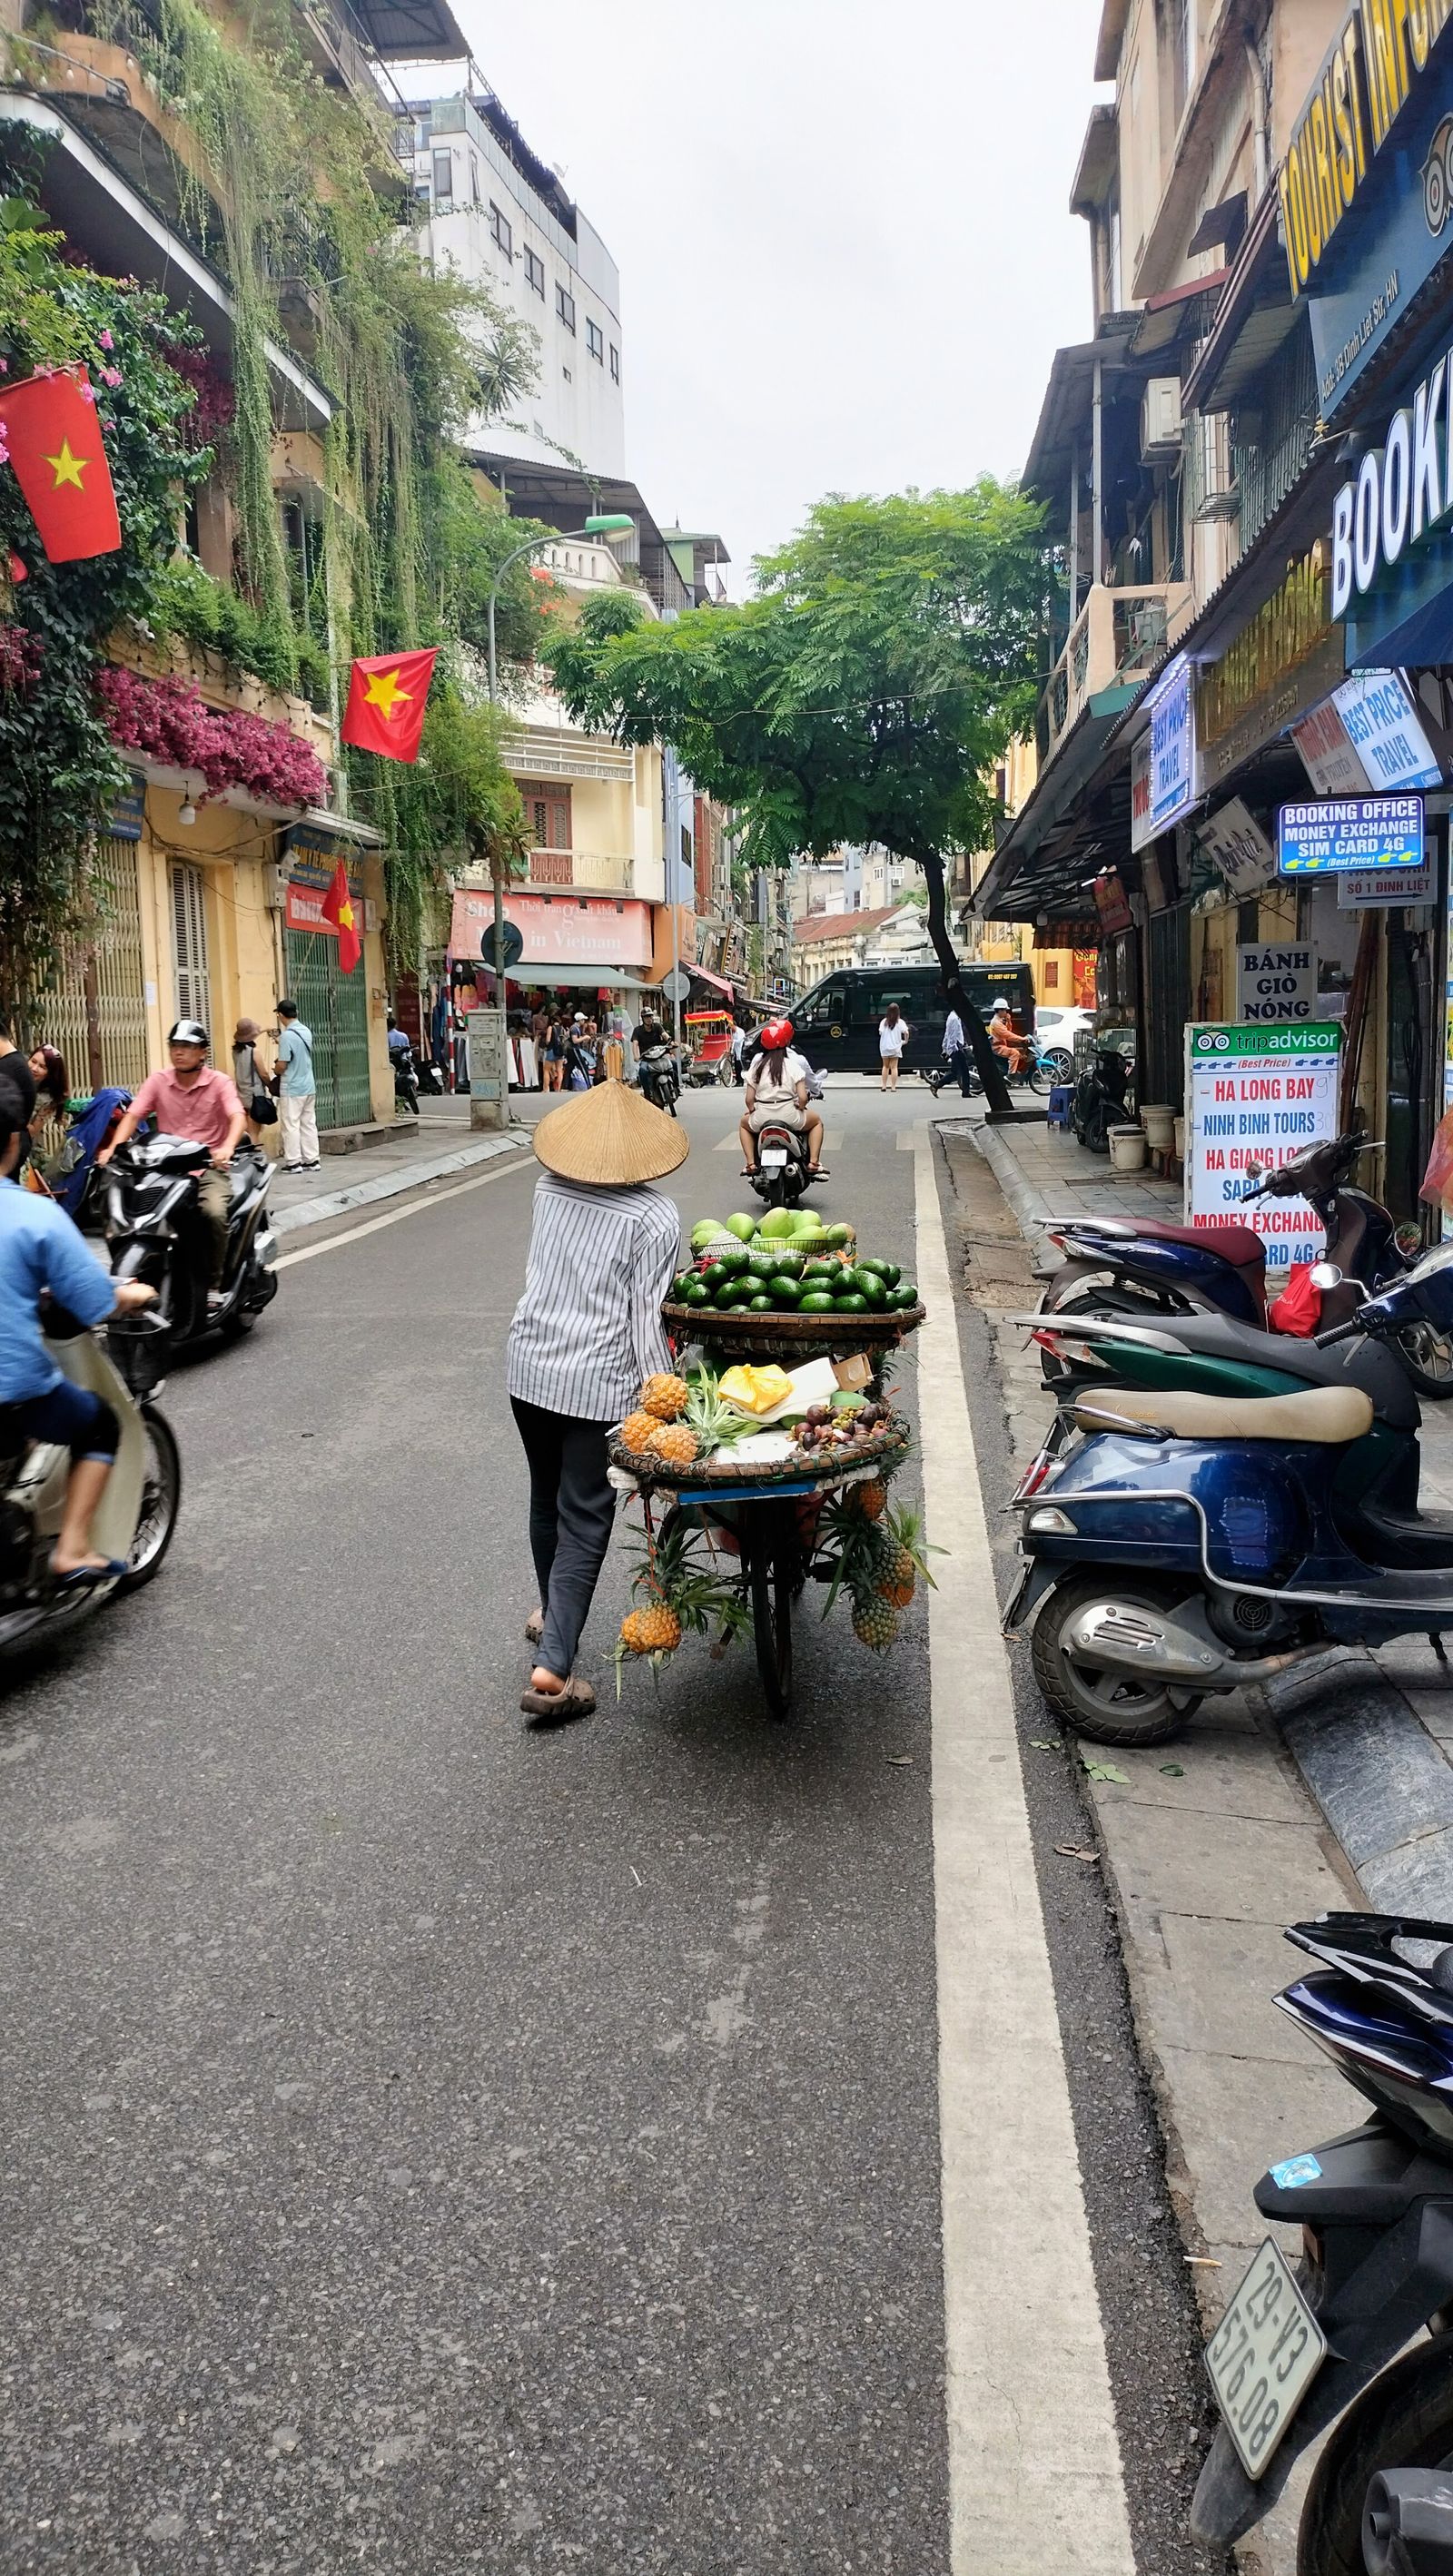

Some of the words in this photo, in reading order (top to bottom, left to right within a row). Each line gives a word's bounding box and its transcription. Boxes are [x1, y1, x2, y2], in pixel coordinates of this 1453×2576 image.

[1278, 9, 1366, 303] TOURIST
[1320, 367, 1337, 403] Add:
[1343, 330, 1360, 369] Dinh
[1359, 310, 1374, 346] Liet
[1385, 269, 1399, 308] HN
[1168, 686, 1189, 741] PRIC
[1341, 702, 1375, 745] BEST
[1365, 680, 1410, 730] PRICE
[1371, 734, 1419, 778] TRAVEL
[1159, 742, 1180, 795] TRAVEL
[1284, 804, 1358, 824] BOOKING
[1362, 800, 1418, 819] OFFICE
[1285, 825, 1337, 842] MONEY
[1340, 820, 1418, 838] EXCHANGE
[1298, 842, 1329, 857] SIM
[1335, 838, 1379, 854] CARD
[1383, 836, 1405, 852] 4G
[1327, 856, 1349, 867] (Best
[1350, 855, 1375, 866] Price)
[1347, 879, 1362, 894] SỐ
[1366, 883, 1371, 893] 1
[1407, 877, 1430, 893] LIỆT
[530, 931, 546, 947] in
[554, 930, 622, 950] Vietnam
[1243, 949, 1310, 972] BÁNH
[1257, 972, 1297, 994] GIÒ
[1243, 998, 1310, 1020] NÓNG
[1236, 1030, 1338, 1053] tripadvisor
[1238, 1059, 1262, 1069] (Best
[1263, 1058, 1290, 1068] Price)
[1215, 1081, 1236, 1101] HA
[1240, 1079, 1281, 1100] LONG
[1286, 1078, 1315, 1099] BAY
[1203, 1114, 1235, 1136] NINH
[1239, 1113, 1270, 1135] BINH
[1274, 1111, 1315, 1134] TOURS
[1206, 1149, 1225, 1170] HA
[1230, 1147, 1273, 1170] GIANG
[1278, 1146, 1305, 1170] LO
[1194, 1213, 1248, 1228] MONEY
[1252, 1211, 1324, 1233] EXCHANG
[1264, 1244, 1289, 1266] ARD
[1293, 1243, 1313, 1264] 4G
[1212, 2306, 1280, 2456] 576.08
